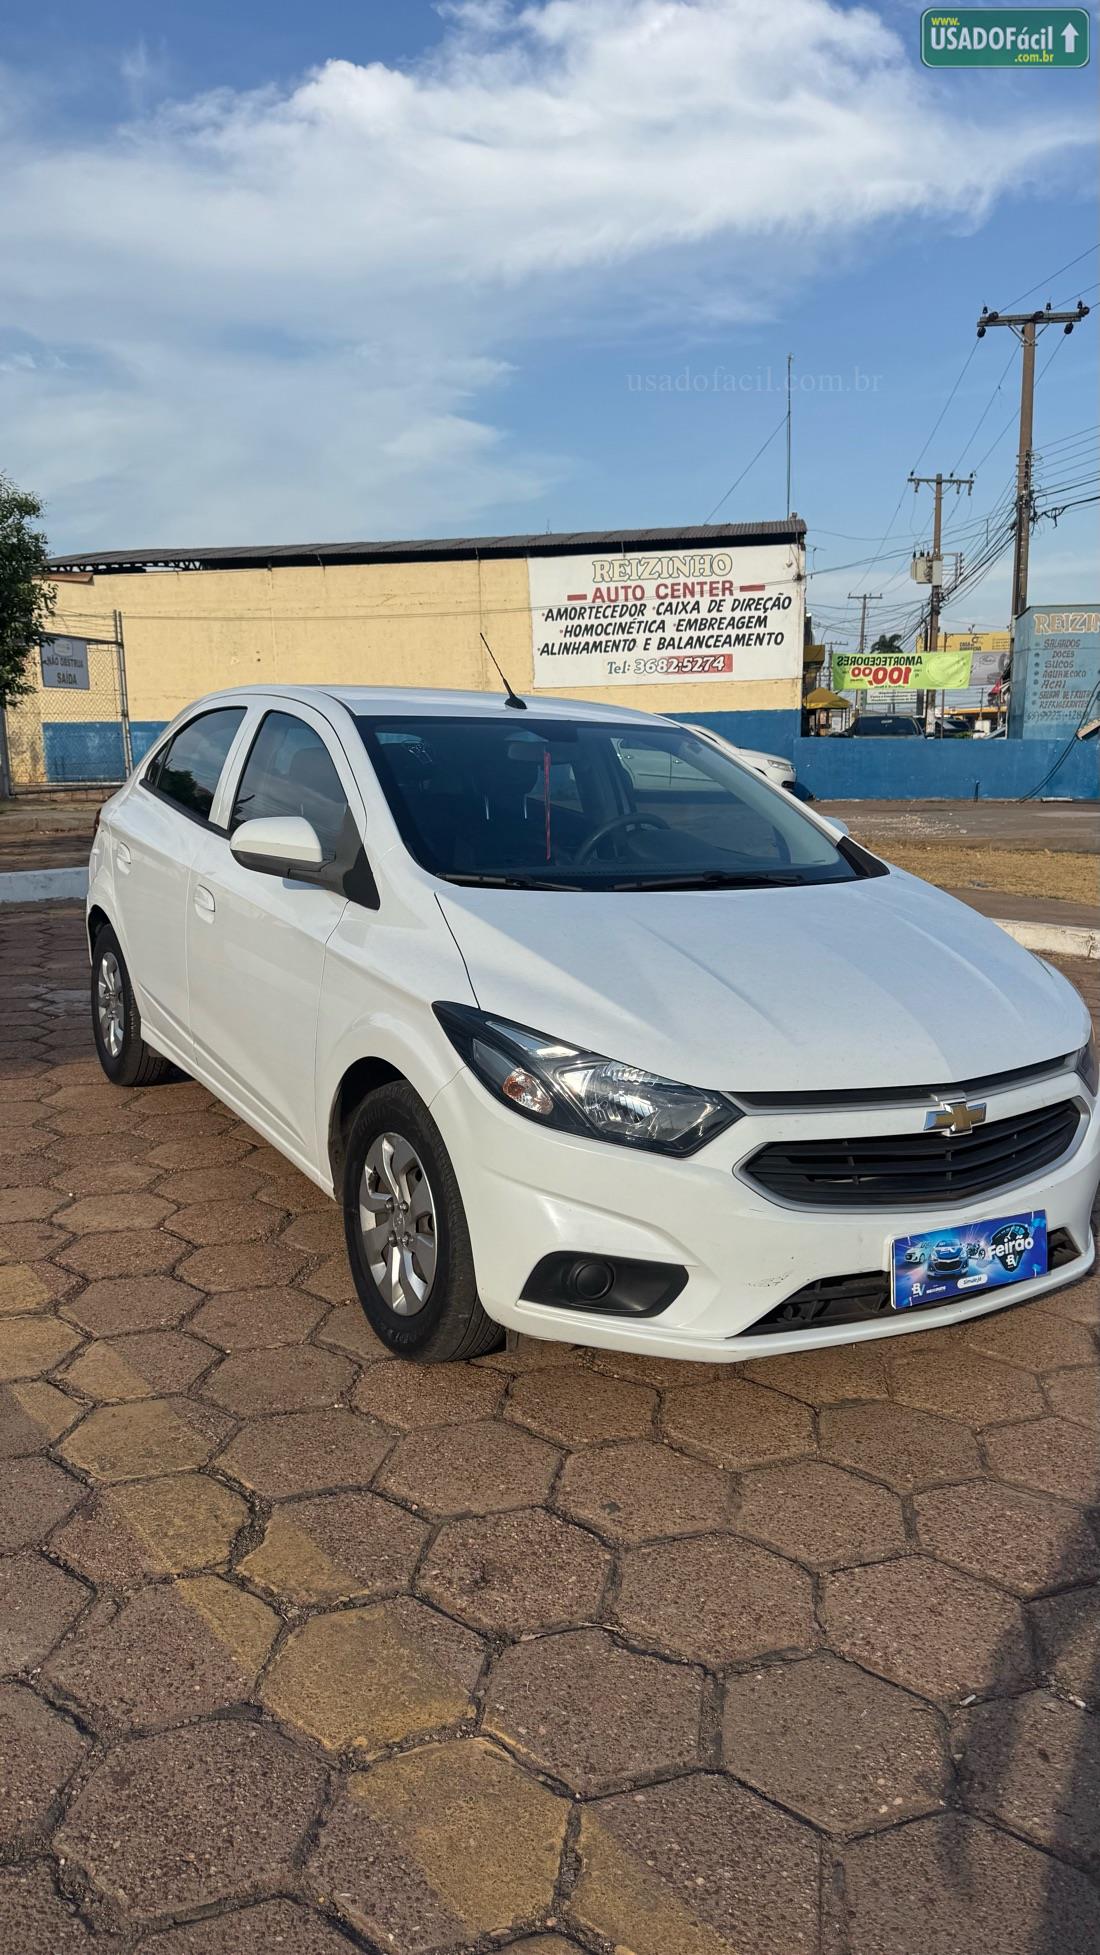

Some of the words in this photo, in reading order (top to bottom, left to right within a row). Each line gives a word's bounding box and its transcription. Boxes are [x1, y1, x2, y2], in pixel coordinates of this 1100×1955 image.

[592, 553, 733, 583] REIZINHO
[591, 584, 646, 603] AUTO
[655, 580, 734, 600] CENTER
[544, 602, 647, 622] AMORTECEDOR
[655, 600, 701, 616] CAIXA
[707, 599, 725, 613] DE
[730, 592, 793, 614] DIREÇÃO
[563, 617, 666, 638] HOMOCINÉTICA
[675, 615, 768, 633] EMBREAGEM
[540, 638, 637, 656] ALINHAMENTO
[643, 637, 652, 651] E
[656, 631, 785, 650] BALANCEAMENTO
[1043, 639, 1081, 649] SALGADOS
[1052, 650, 1075, 659] DOCES
[607, 661, 631, 675] Tel:
[1044, 660, 1074, 669] SUCOS
[988, 1234, 1035, 1262] Feirão
